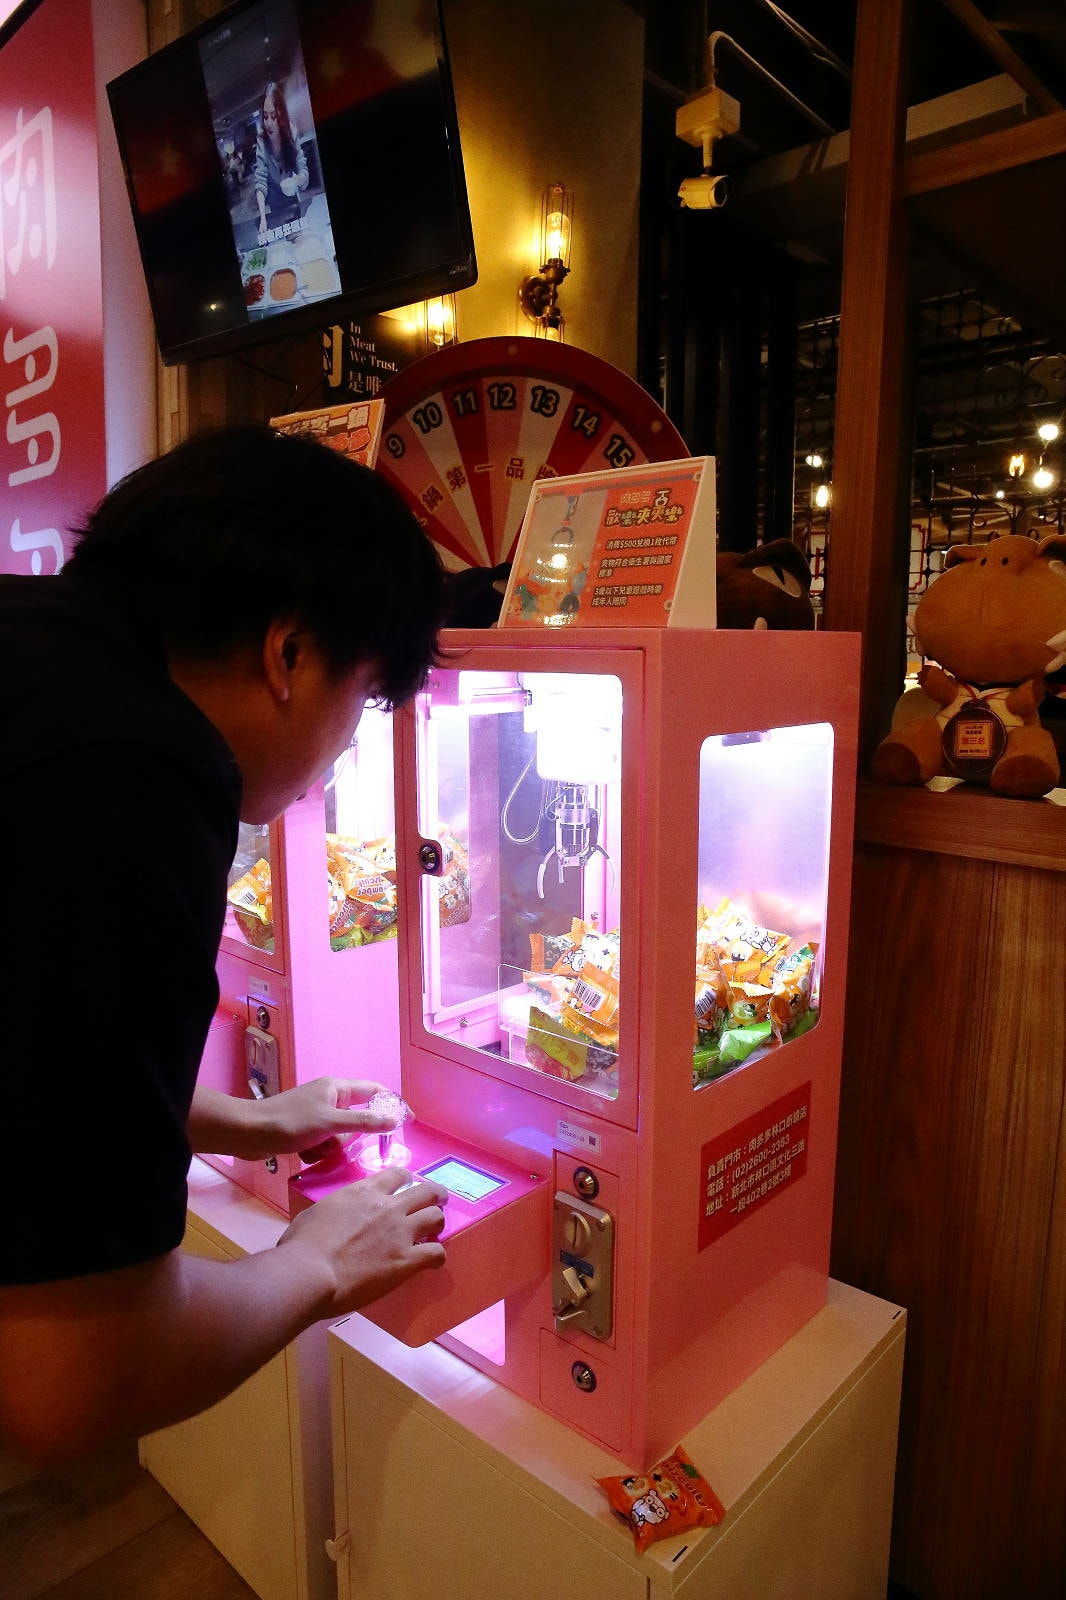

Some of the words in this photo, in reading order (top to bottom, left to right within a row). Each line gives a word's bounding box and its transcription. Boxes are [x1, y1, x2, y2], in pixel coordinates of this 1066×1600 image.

[350, 321, 361, 334] In
[0, 106, 64, 575] 肉多
[350, 335, 376, 353] Meat
[349, 350, 367, 363] We
[369, 354, 399, 373] Trust.
[455, 392, 477, 415] 11
[490, 386, 514, 408] 12
[532, 389, 558, 415] 13
[415, 405, 441, 431] 10
[573, 409, 599, 434] 14
[387, 434, 404, 457] 9
[606, 437, 633, 466] 15
